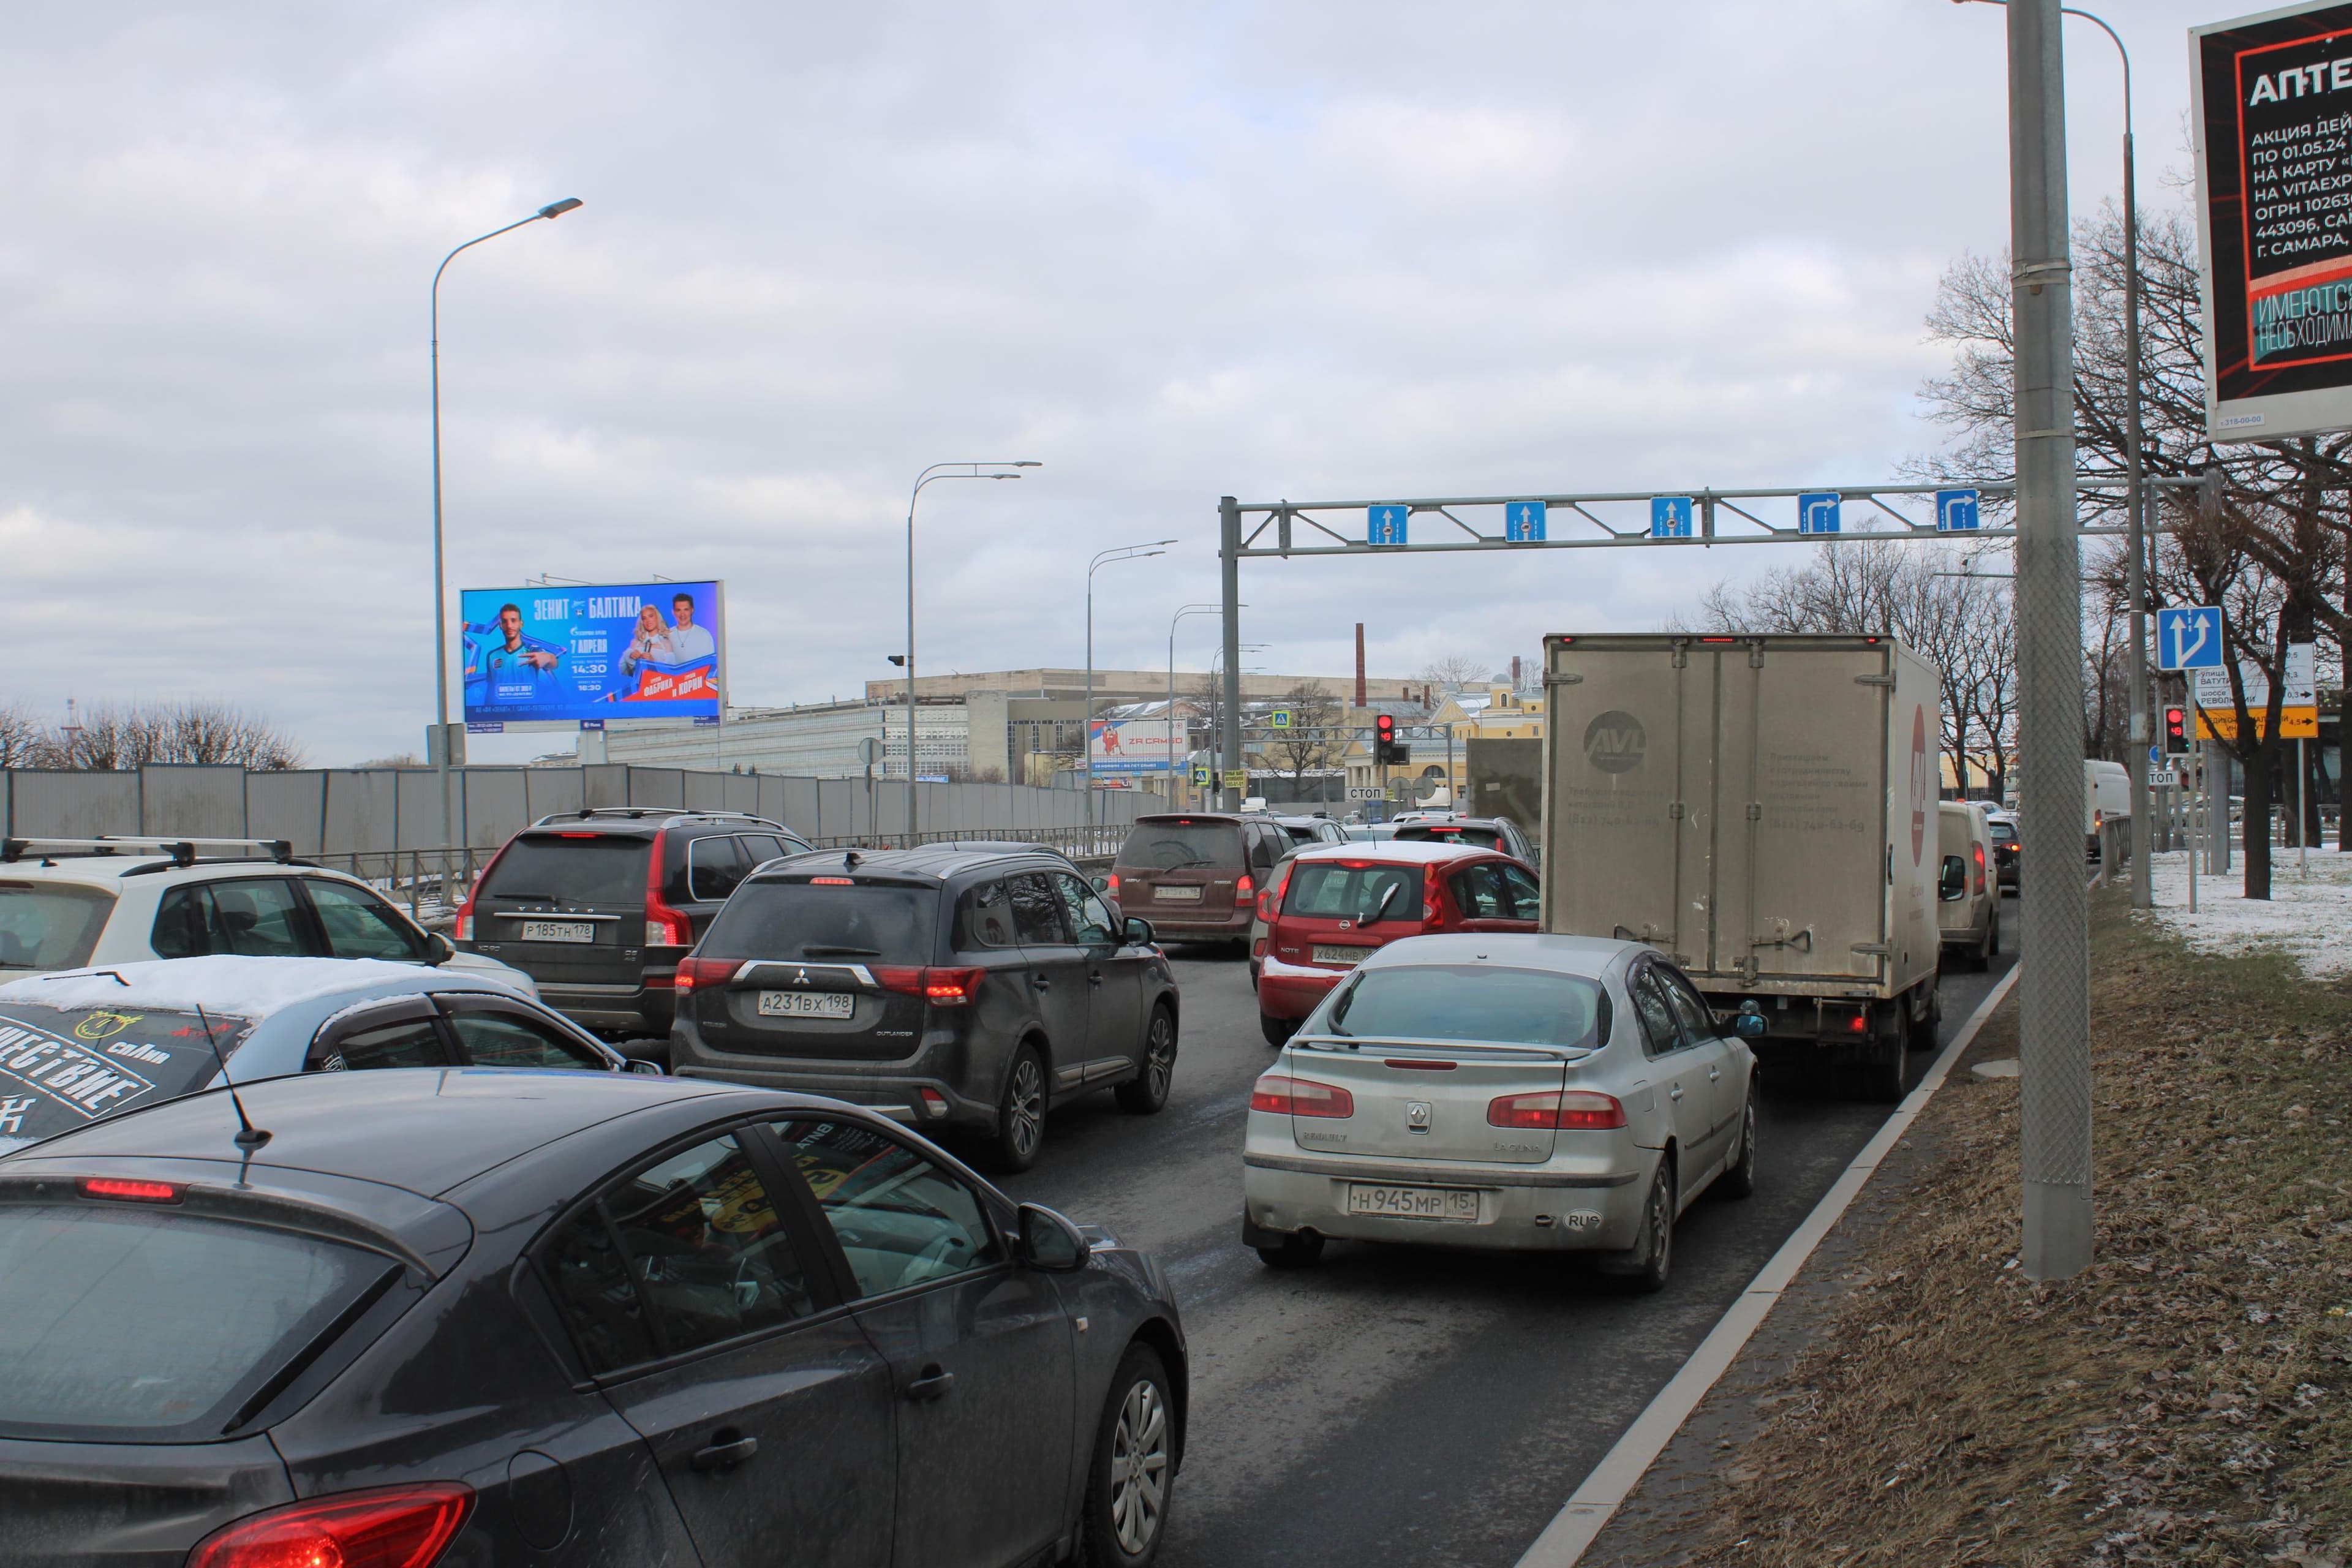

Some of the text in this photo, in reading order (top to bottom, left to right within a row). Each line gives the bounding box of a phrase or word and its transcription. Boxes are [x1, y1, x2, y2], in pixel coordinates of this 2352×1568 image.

[2252, 123, 2311, 146] АКЦИЯ
[2253, 137, 2346, 165] ПО 01.05.24
[2254, 157, 2337, 183] НА КАРТУ
[2255, 173, 2352, 202] НА VITAEXP
[2255, 192, 2352, 221] ОГРН 10263
[2256, 217, 2320, 238] 443096,
[2258, 232, 2349, 258] Г. САМАРА,
[534, 596, 641, 620] ЗЕНИТ БАЛТИКА
[570, 639, 607, 654] 7 АПРЕЛЯ
[571, 664, 606, 673] 14:30
[644, 678, 673, 697] ФАБРИКА
[679, 676, 703, 696] КОРНИ
[2171, 726, 2182, 736] 49
[1586, 728, 1646, 757] AVL
[2149, 773, 2173, 783] ТОП
[1351, 789, 1380, 798] СТОП
[574, 924, 590, 935] 178
[763, 993, 849, 1012] А231ВХ 198
[1303, 1133, 1348, 1142] RENAULT
[1493, 1142, 1542, 1153] LAGUNA
[1359, 1189, 1469, 1213] Н945МР 15
[1569, 1215, 1599, 1226] RUS
